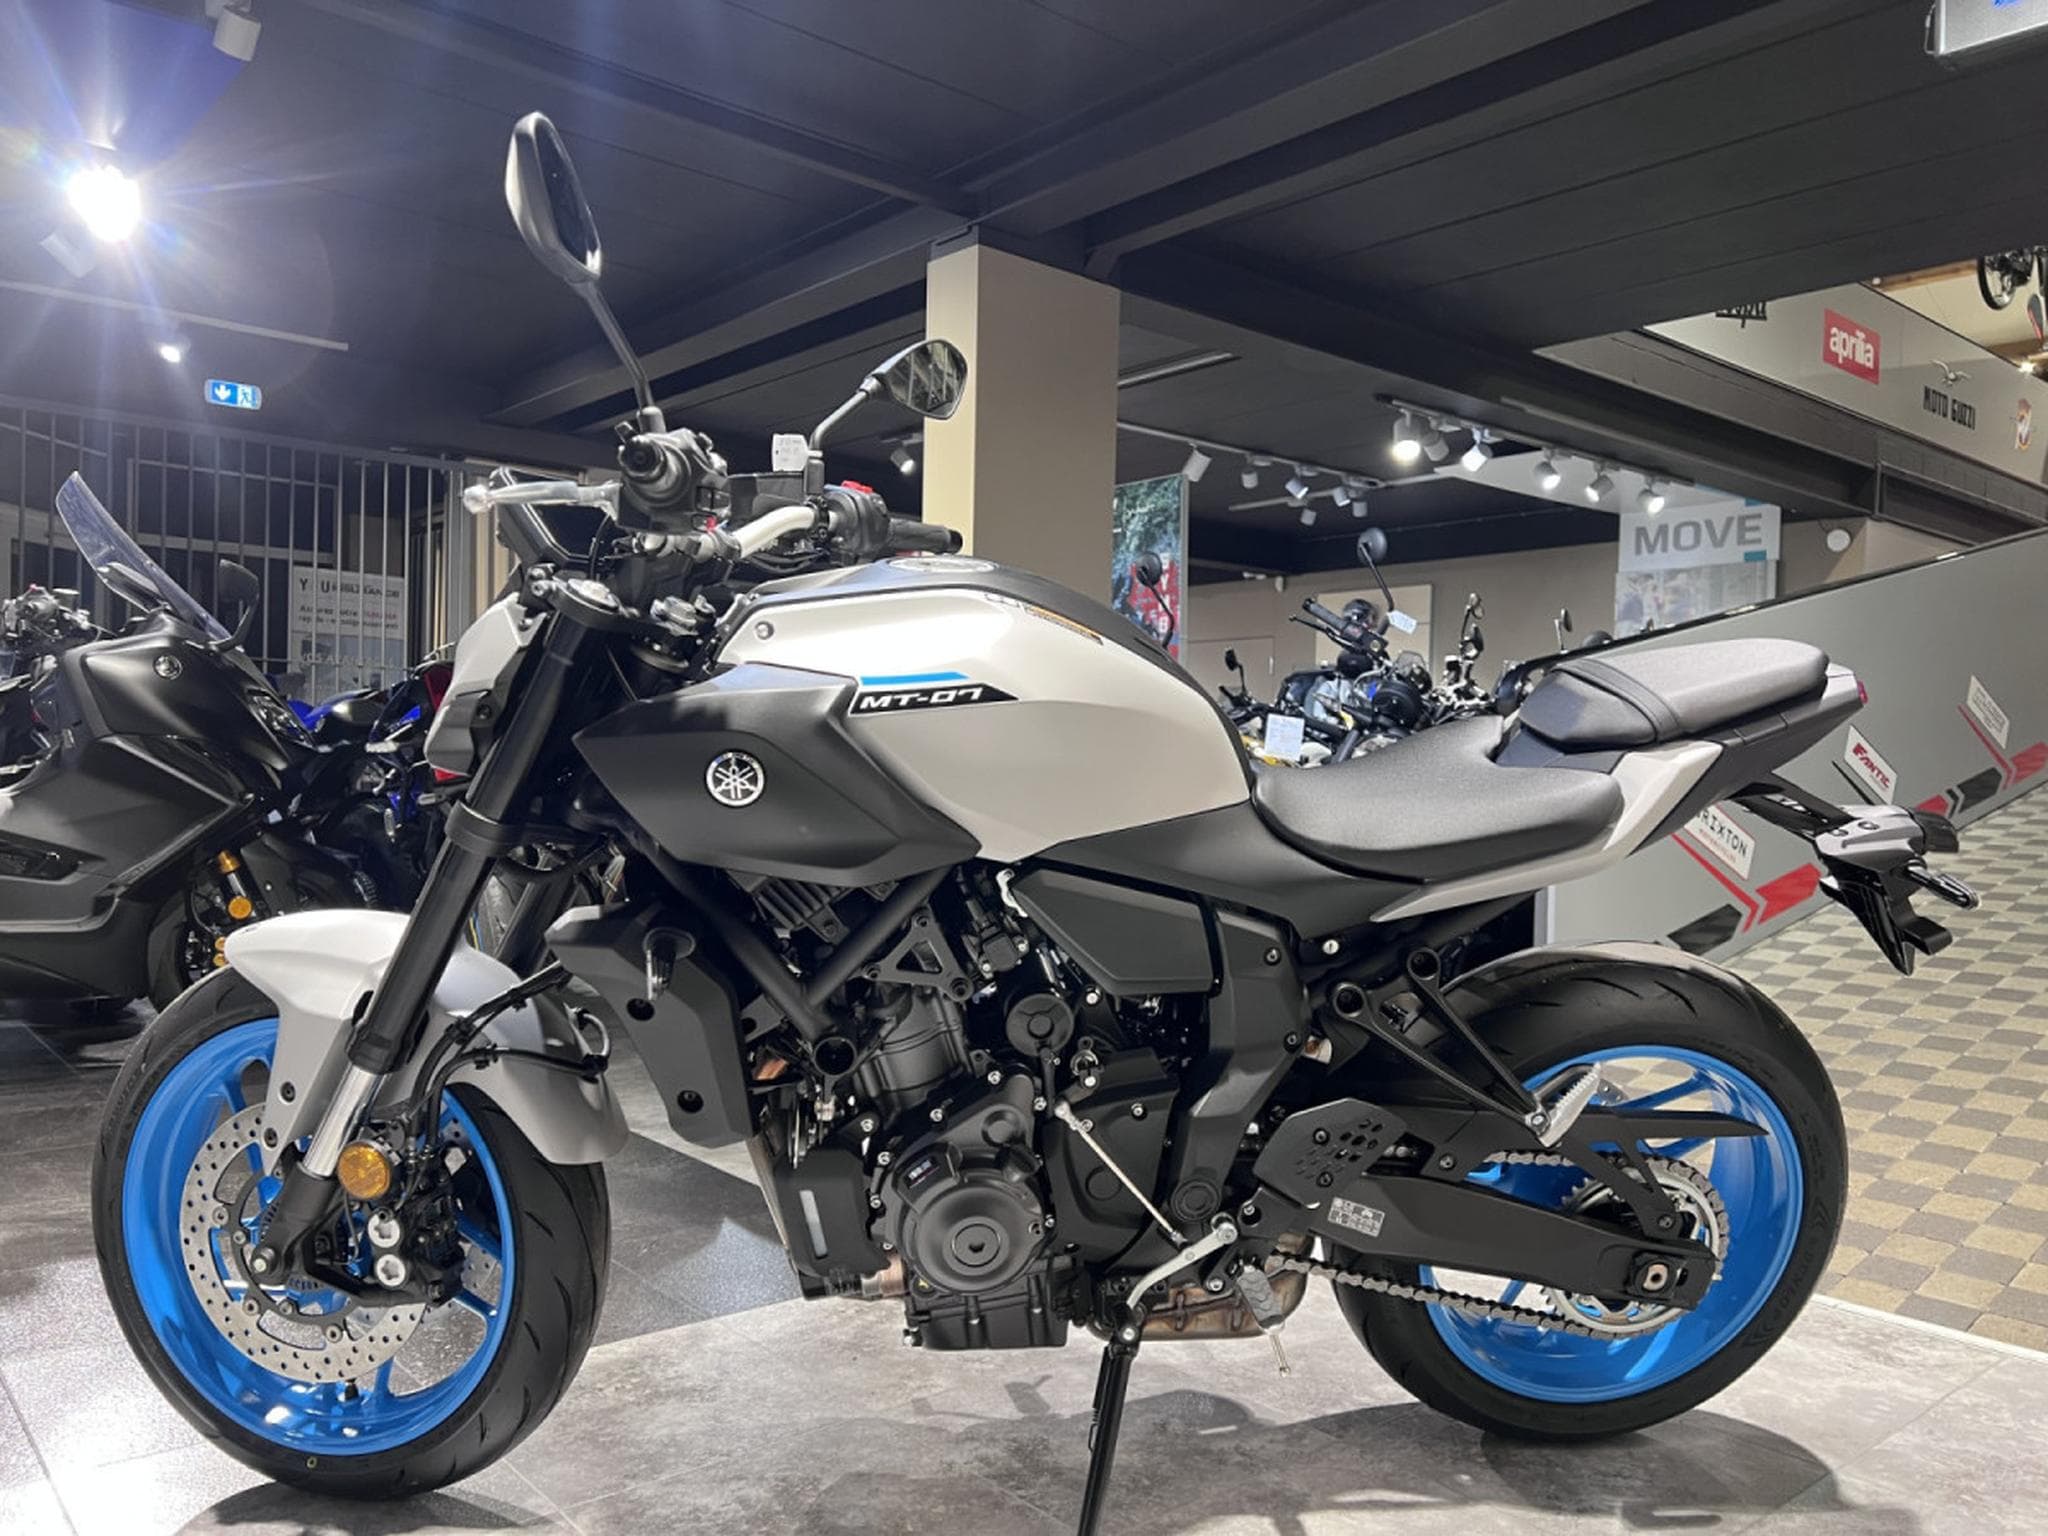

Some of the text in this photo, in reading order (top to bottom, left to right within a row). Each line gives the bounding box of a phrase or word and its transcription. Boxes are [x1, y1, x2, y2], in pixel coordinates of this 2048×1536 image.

[1829, 326, 1875, 369] aprilia
[1922, 385, 1949, 419] MOTO
[1951, 398, 1977, 431] GUZZI
[1634, 513, 1763, 556] MOVE
[859, 687, 984, 710] MT-07
[1852, 742, 1890, 789] FANTIC
[1698, 808, 1749, 857] RIXTON
